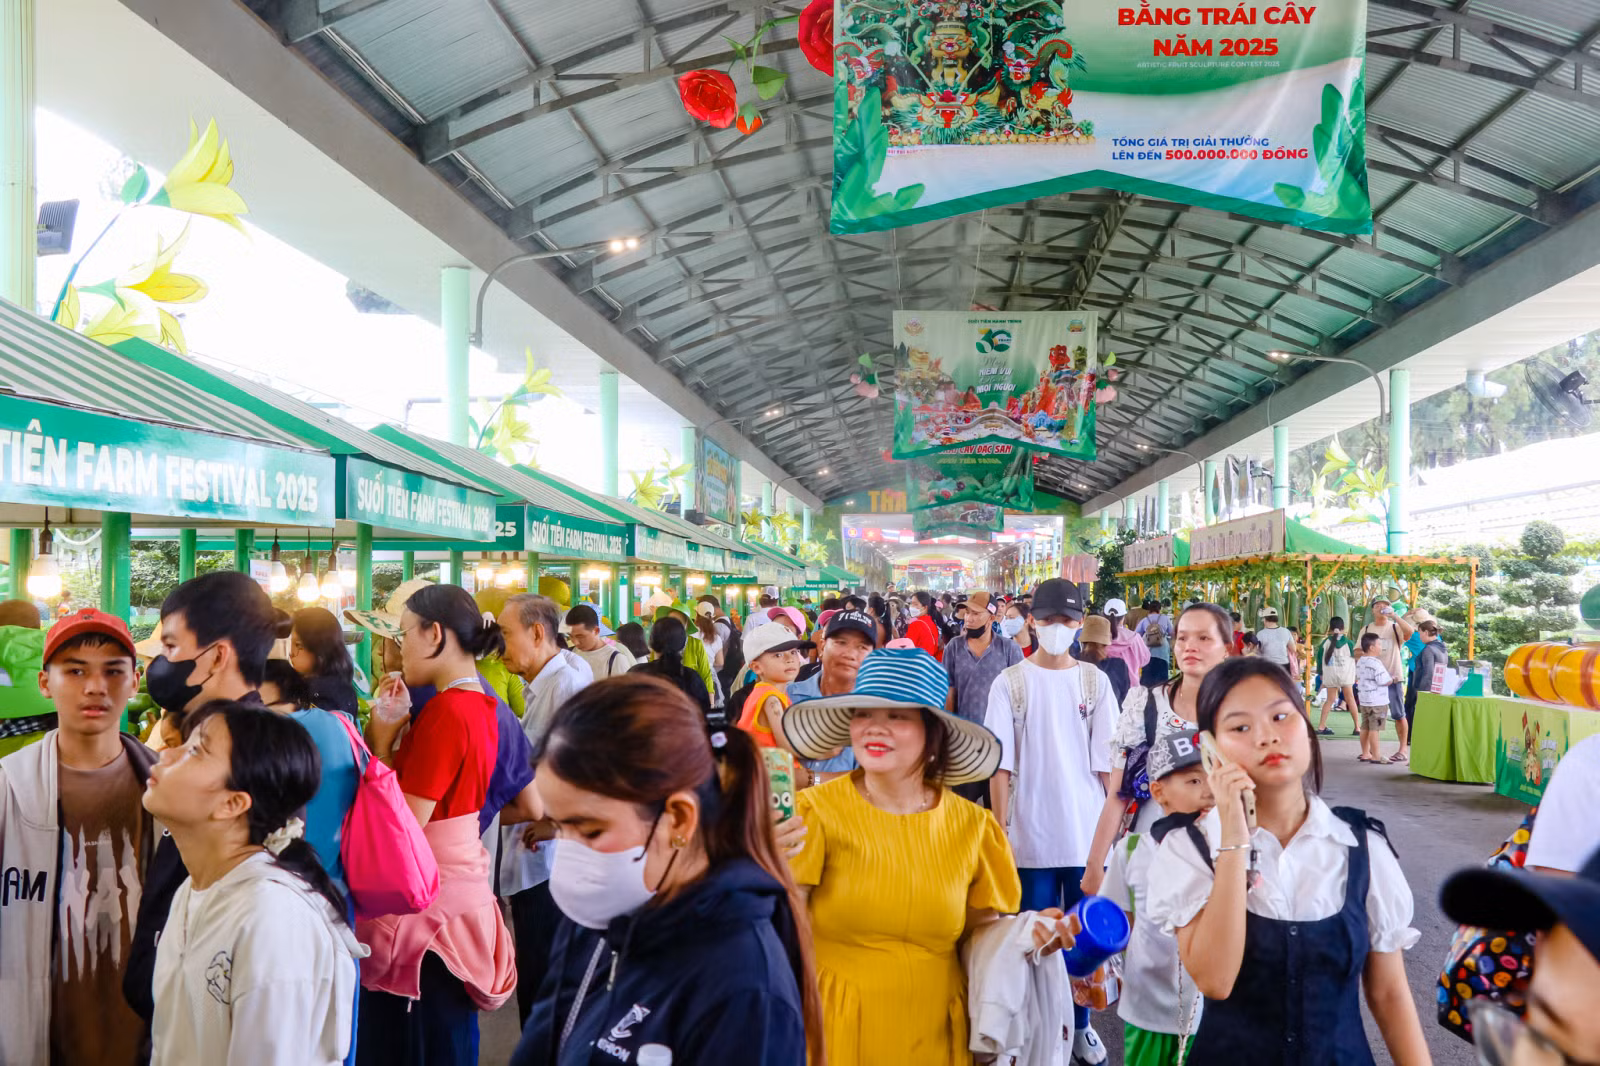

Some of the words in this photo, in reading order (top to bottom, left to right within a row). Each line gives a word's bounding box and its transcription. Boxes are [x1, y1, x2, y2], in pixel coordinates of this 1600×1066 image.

[1118, 0, 1191, 26] BẰNG
[1197, 2, 1257, 26] TRÁI
[1264, 1, 1317, 25] CÂY
[1153, 34, 1213, 57] NĂM
[1219, 38, 1279, 57] 2025
[1112, 149, 1136, 160] LÊN
[1137, 148, 1162, 160] ĐẾN
[1165, 149, 1258, 161] 500.000.000
[1147, 136, 1168, 147] GIÁ
[1171, 138, 1189, 149] TRỊ
[1192, 135, 1217, 147] GIẢI
[0, 418, 67, 488] TIÊN
[76, 441, 158, 497] FARM
[166, 455, 271, 509] FESTIVAL
[276, 472, 318, 513] 2025
[357, 471, 385, 514] SUỐI
[387, 480, 409, 519] TIÊN
[410, 491, 435, 524] FARM
[437, 497, 473, 530] FESTIVAL
[532, 514, 550, 545] SUỐI
[550, 520, 565, 547] TIÊN
[565, 527, 583, 551] FARM
[583, 531, 608, 554] FESTIVAL
